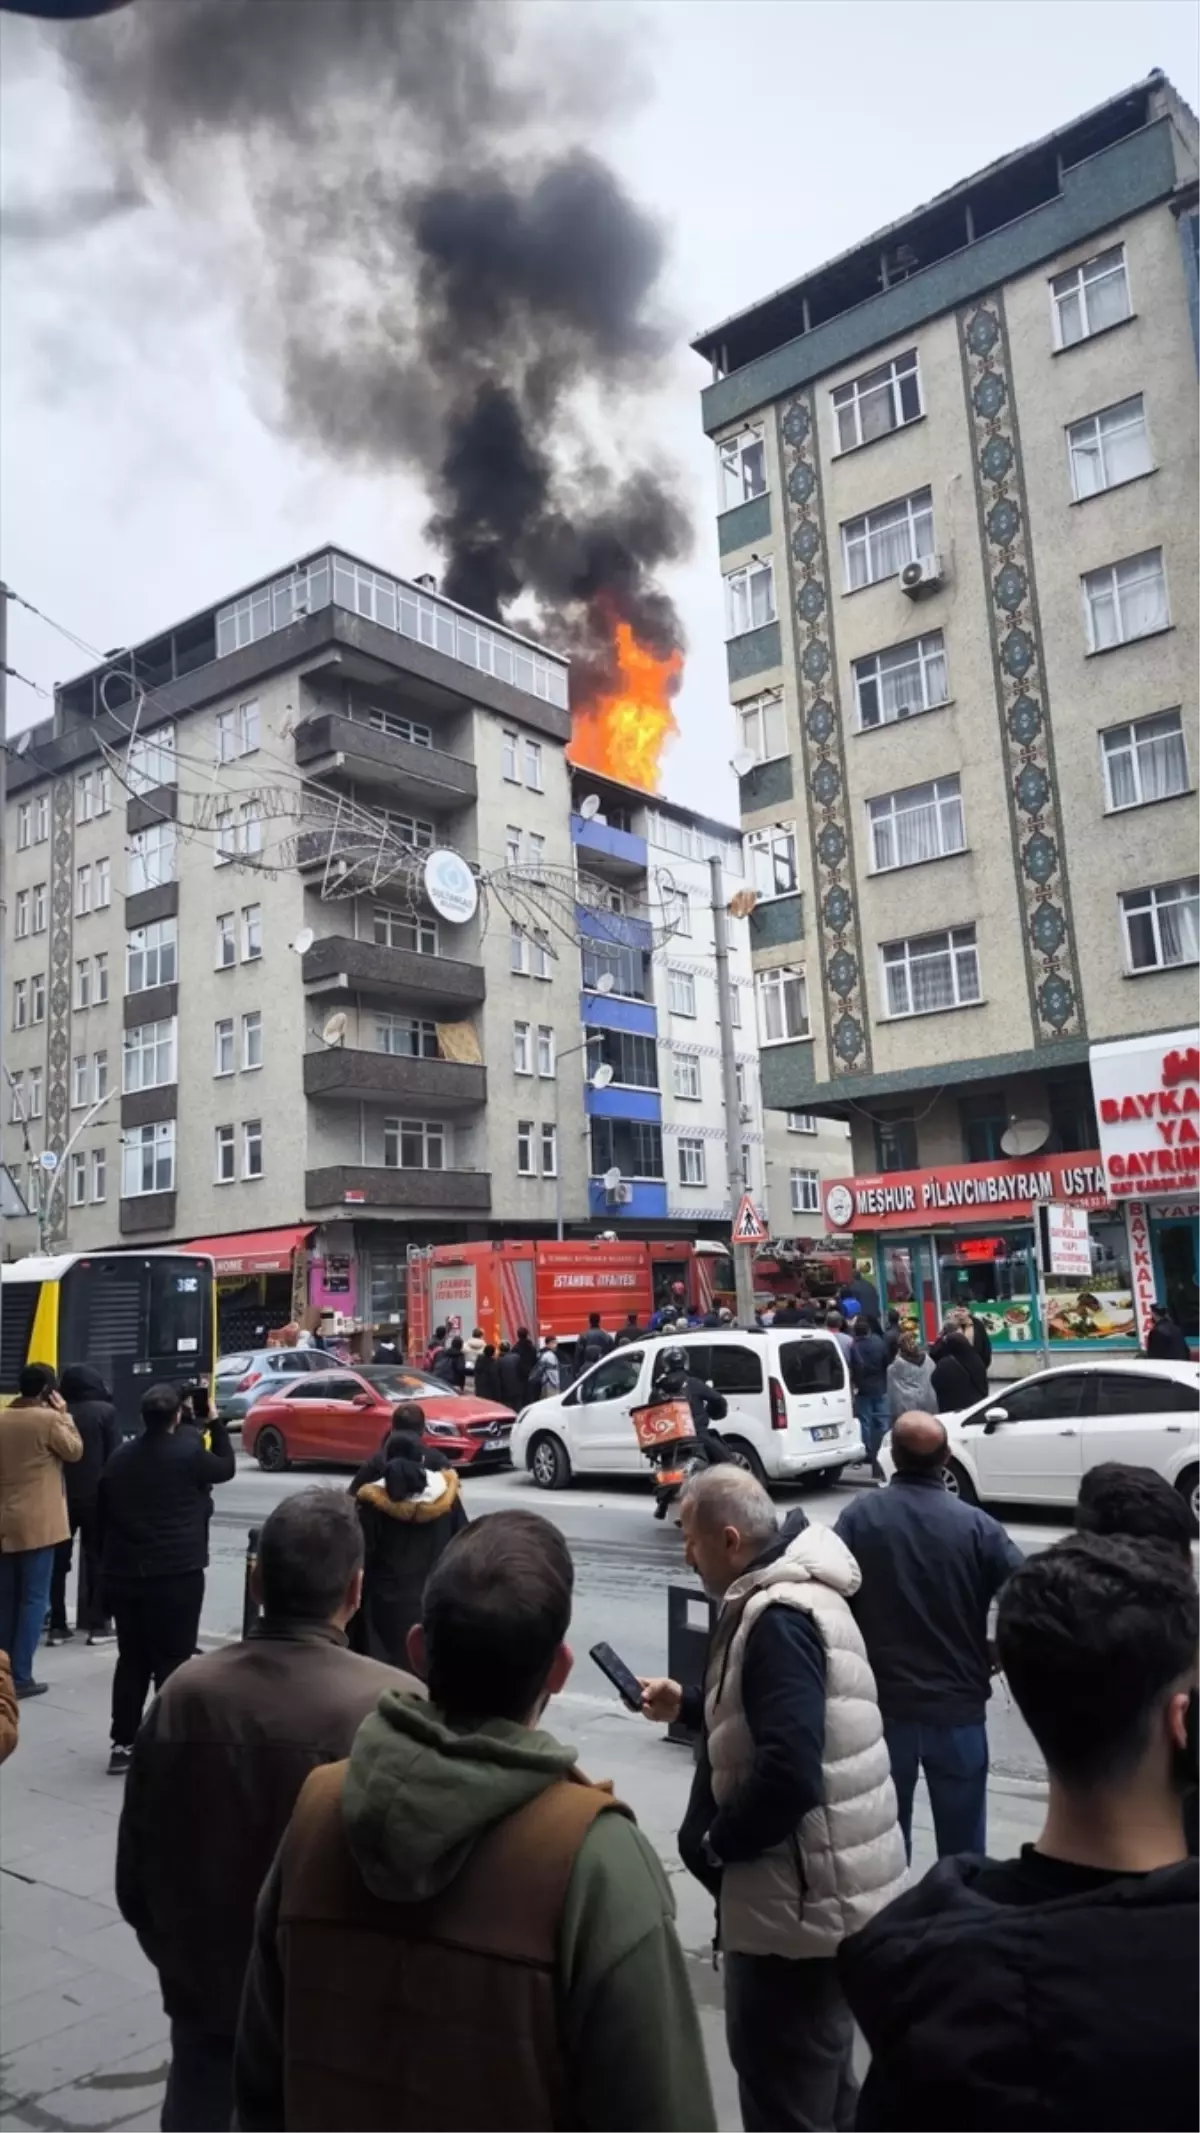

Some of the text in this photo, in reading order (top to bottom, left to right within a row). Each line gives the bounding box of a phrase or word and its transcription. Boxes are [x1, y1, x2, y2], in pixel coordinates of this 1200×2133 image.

[856, 1185, 916, 1217] MEŞHUR
[987, 1171, 1053, 1202] BAYRAM
[1061, 1165, 1106, 1195] USTA
